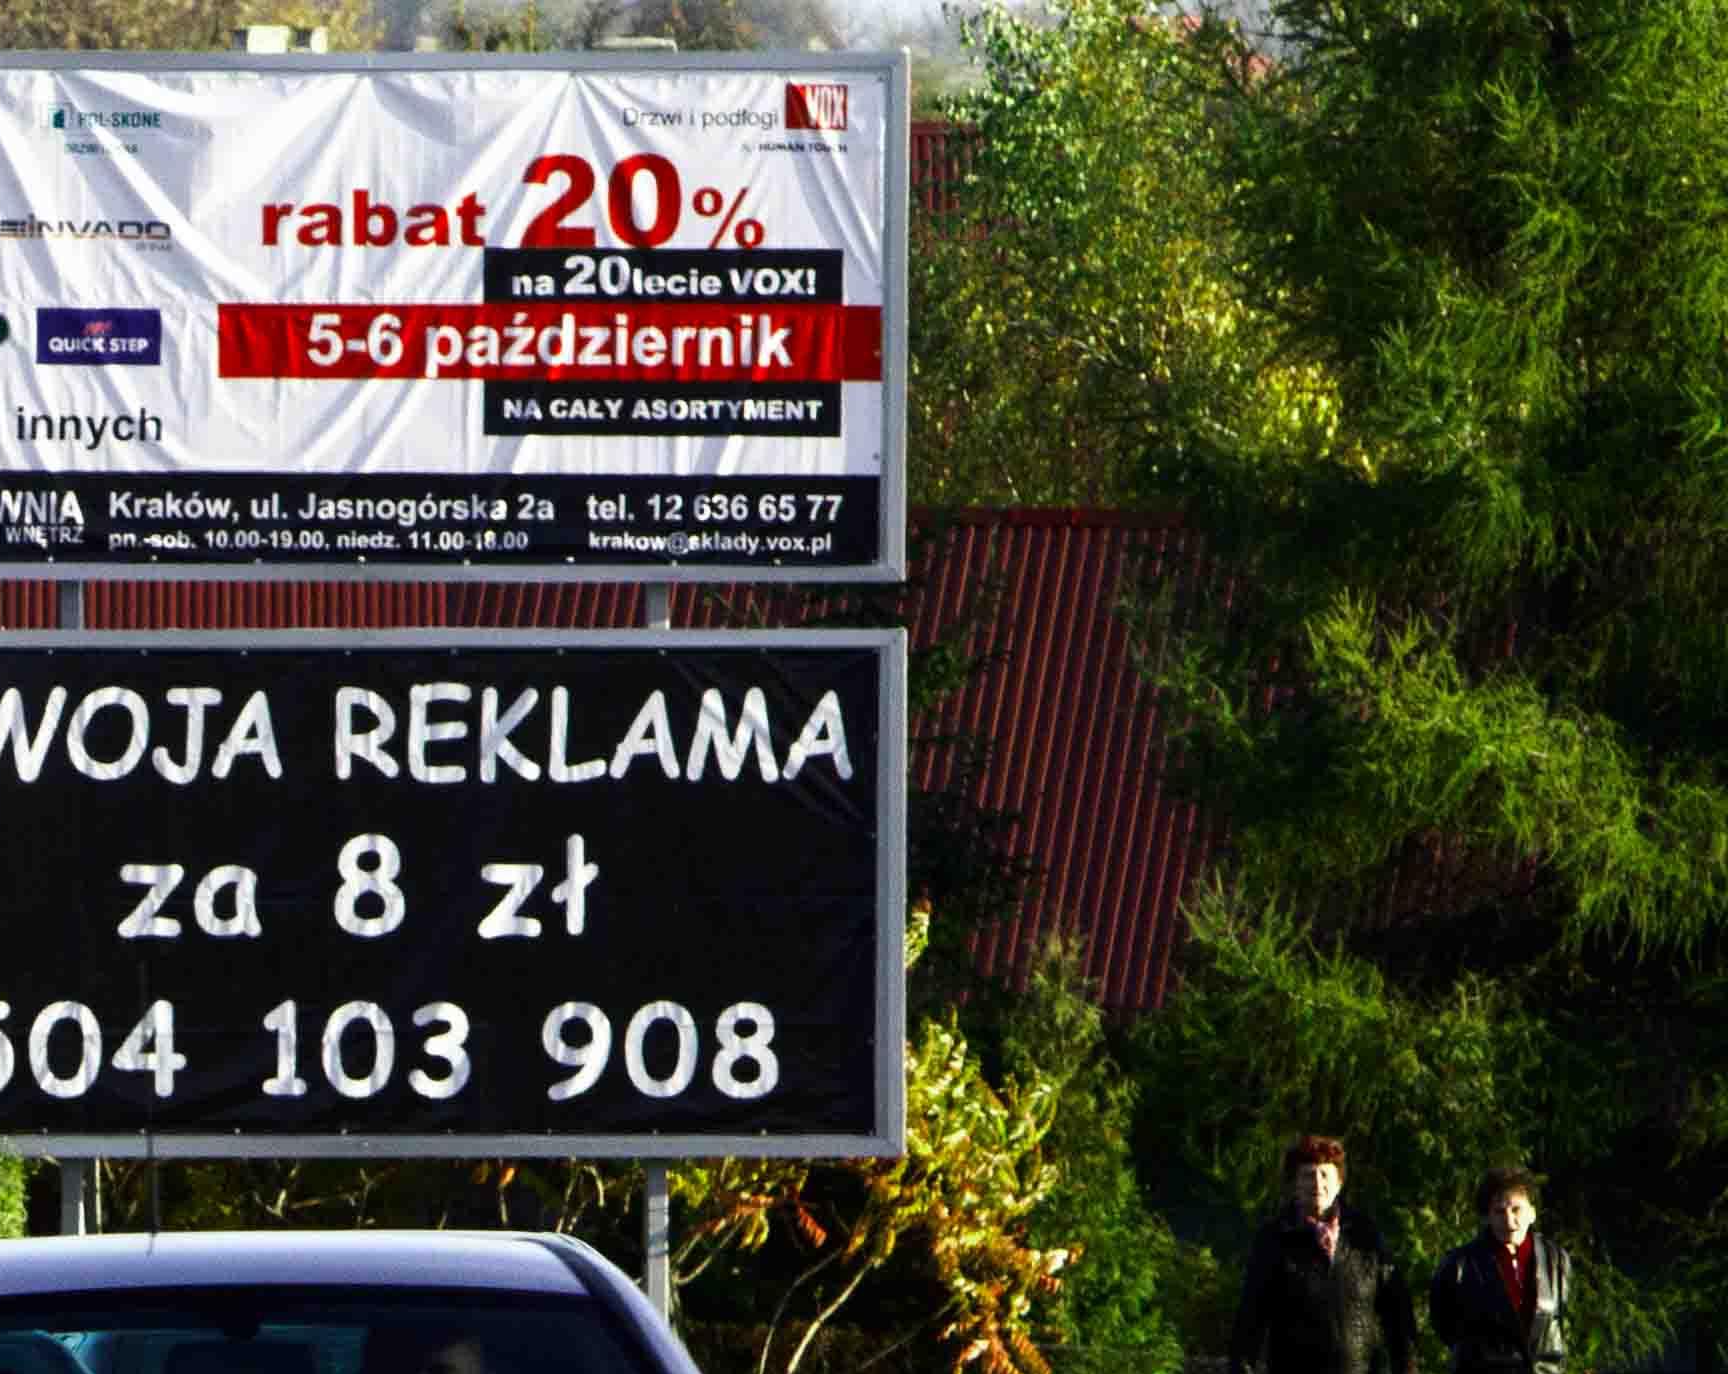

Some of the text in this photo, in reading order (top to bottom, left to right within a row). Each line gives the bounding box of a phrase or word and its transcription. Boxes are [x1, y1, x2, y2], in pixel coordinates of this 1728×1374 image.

[623, 108, 682, 127] Drzwi
[702, 107, 779, 130] podłogi
[805, 85, 846, 129] VOX
[262, 152, 766, 249] rabat 20%
[512, 255, 817, 297] na 20lecie VOX!
[49, 336, 149, 353] QUICK STEP
[307, 310, 792, 377] 5-6 październik
[17, 406, 162, 450] innych
[504, 399, 823, 421] NA CAŁY ASORTYMENT
[109, 490, 555, 527] Kraków, ul. Jasnogórska 2a
[586, 493, 843, 521] tel. 12 636 65 77
[336, 530, 401, 549] niedz.
[588, 531, 832, 556] krakow@sklady.vox.pl
[335, 681, 853, 785] REKLAMA
[117, 833, 599, 938] za 8 zł
[261, 1000, 472, 1101] 103
[542, 1000, 780, 1101] 908
